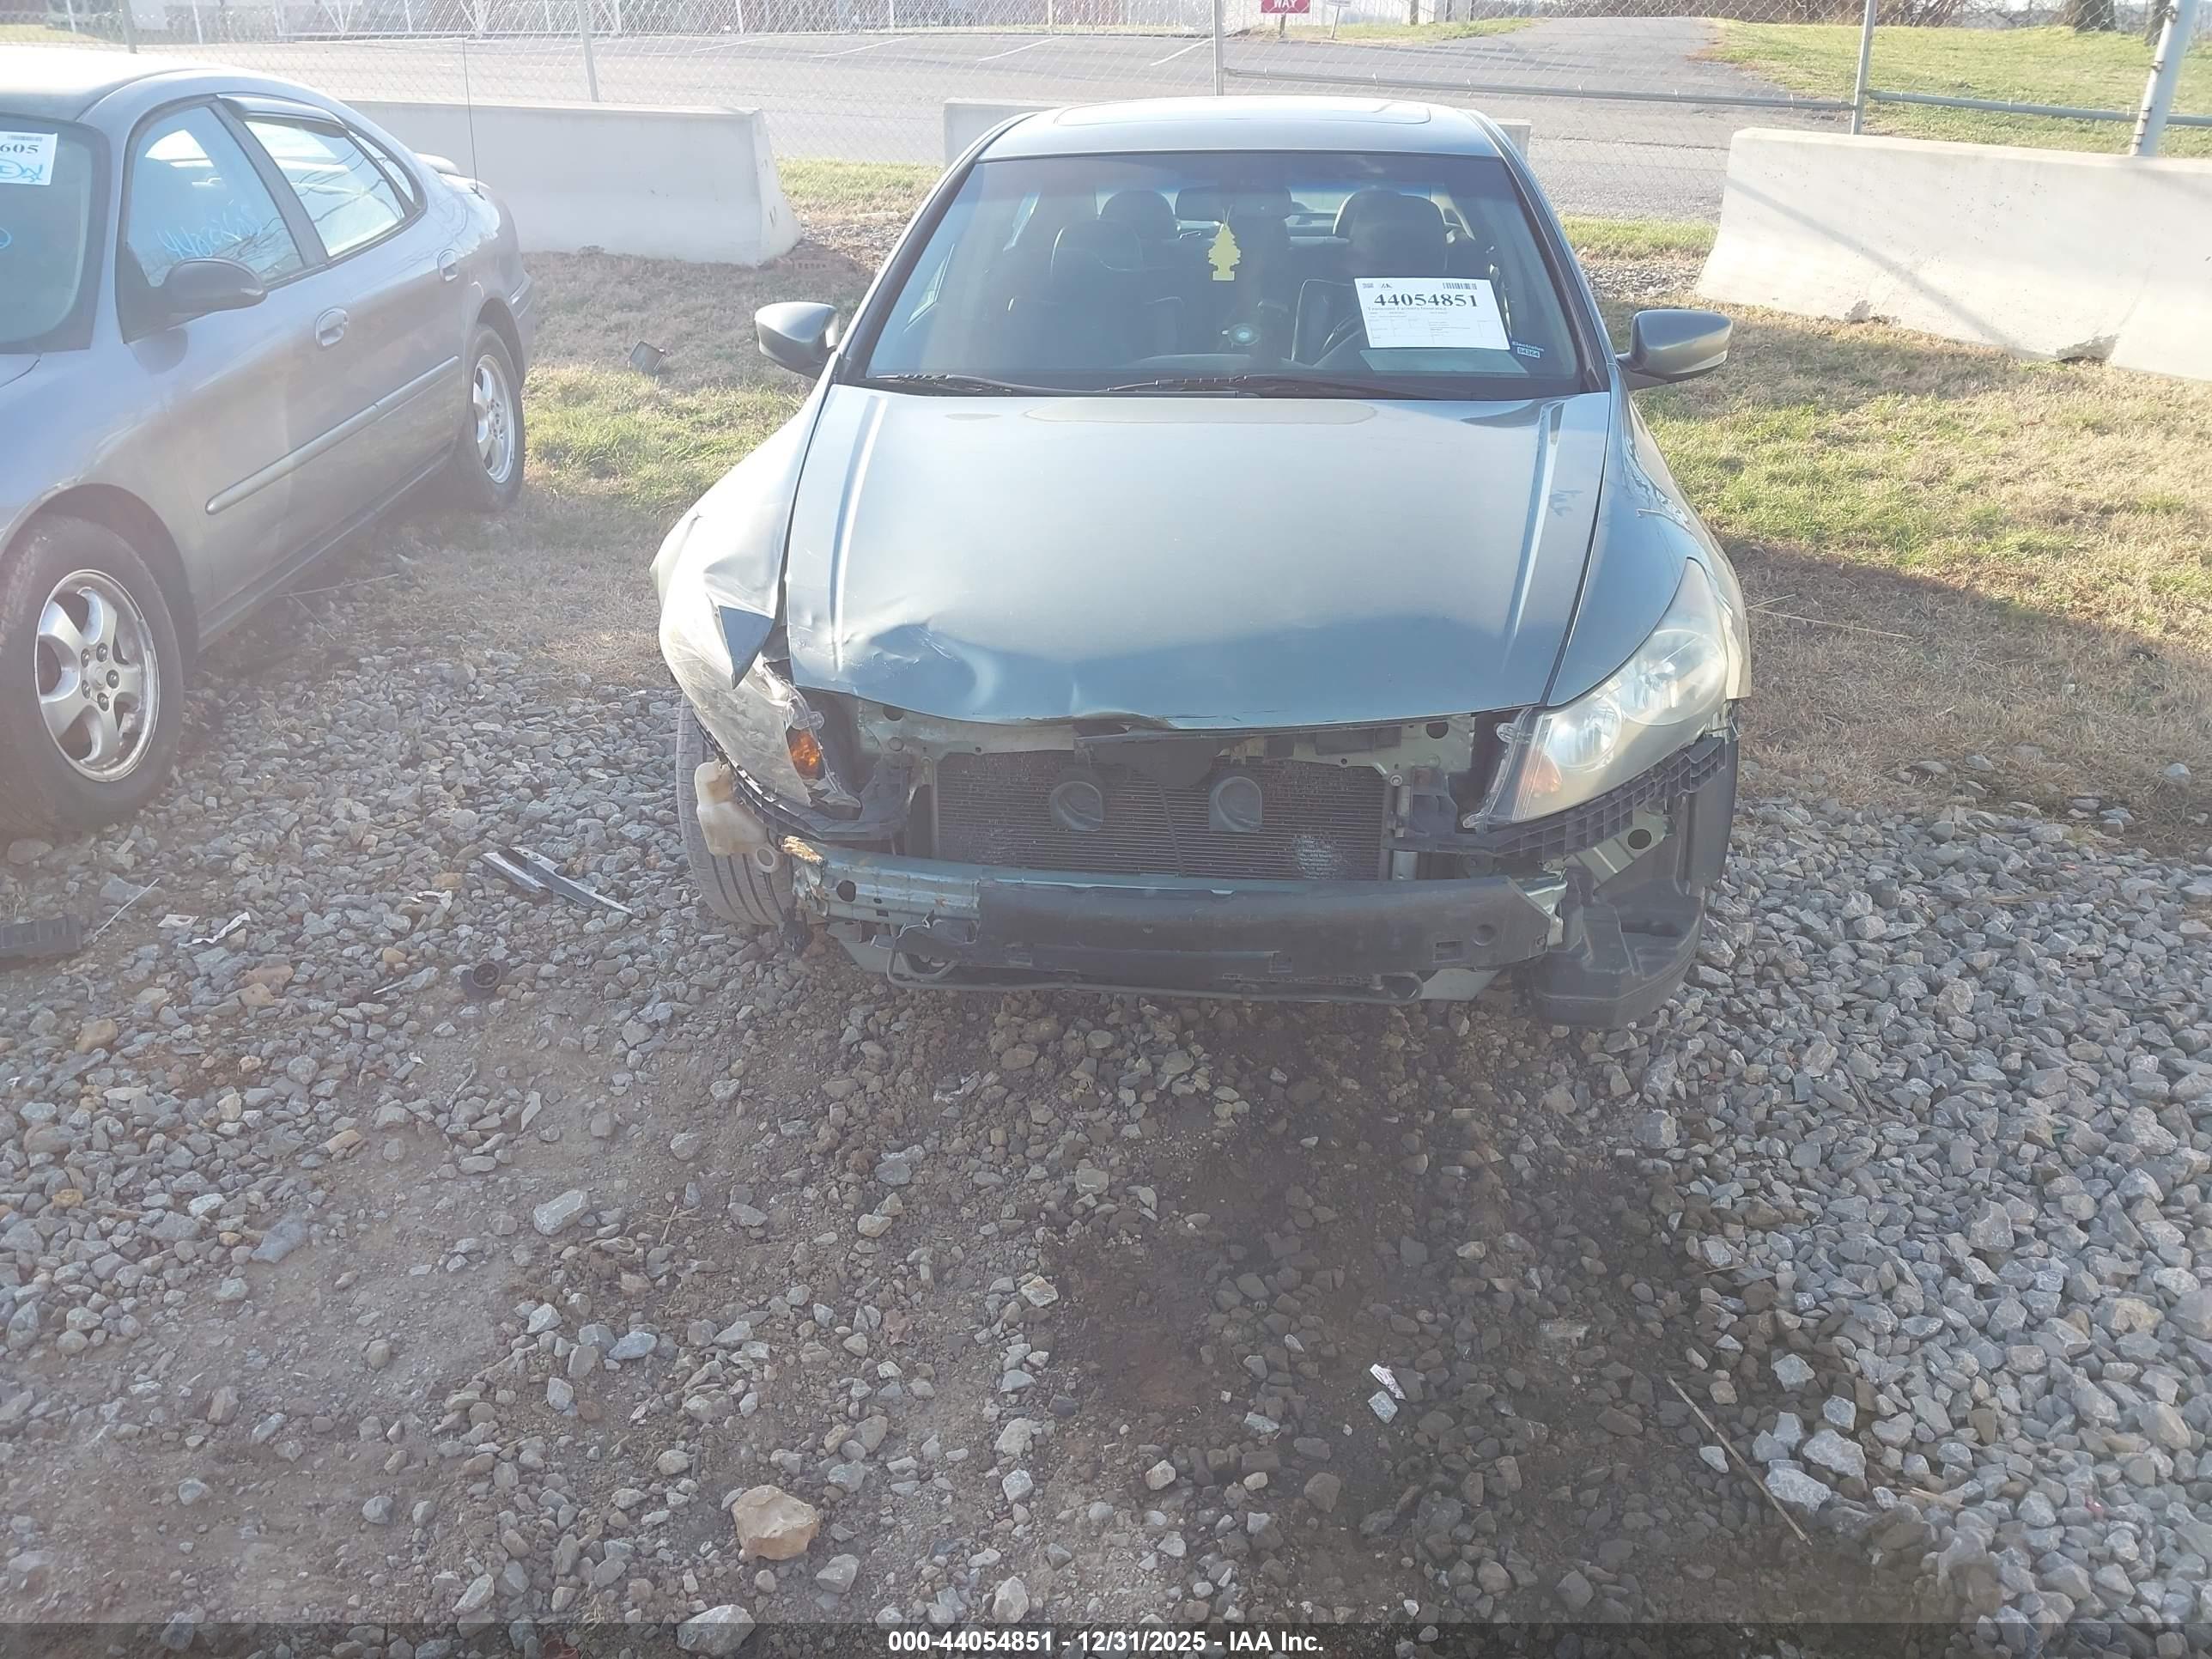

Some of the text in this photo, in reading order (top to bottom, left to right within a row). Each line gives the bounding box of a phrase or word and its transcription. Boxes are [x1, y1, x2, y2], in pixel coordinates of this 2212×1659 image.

[1273, 0, 1297, 9] WAY
[0, 143, 40, 155] 605
[1374, 293, 1478, 307] 44054851
